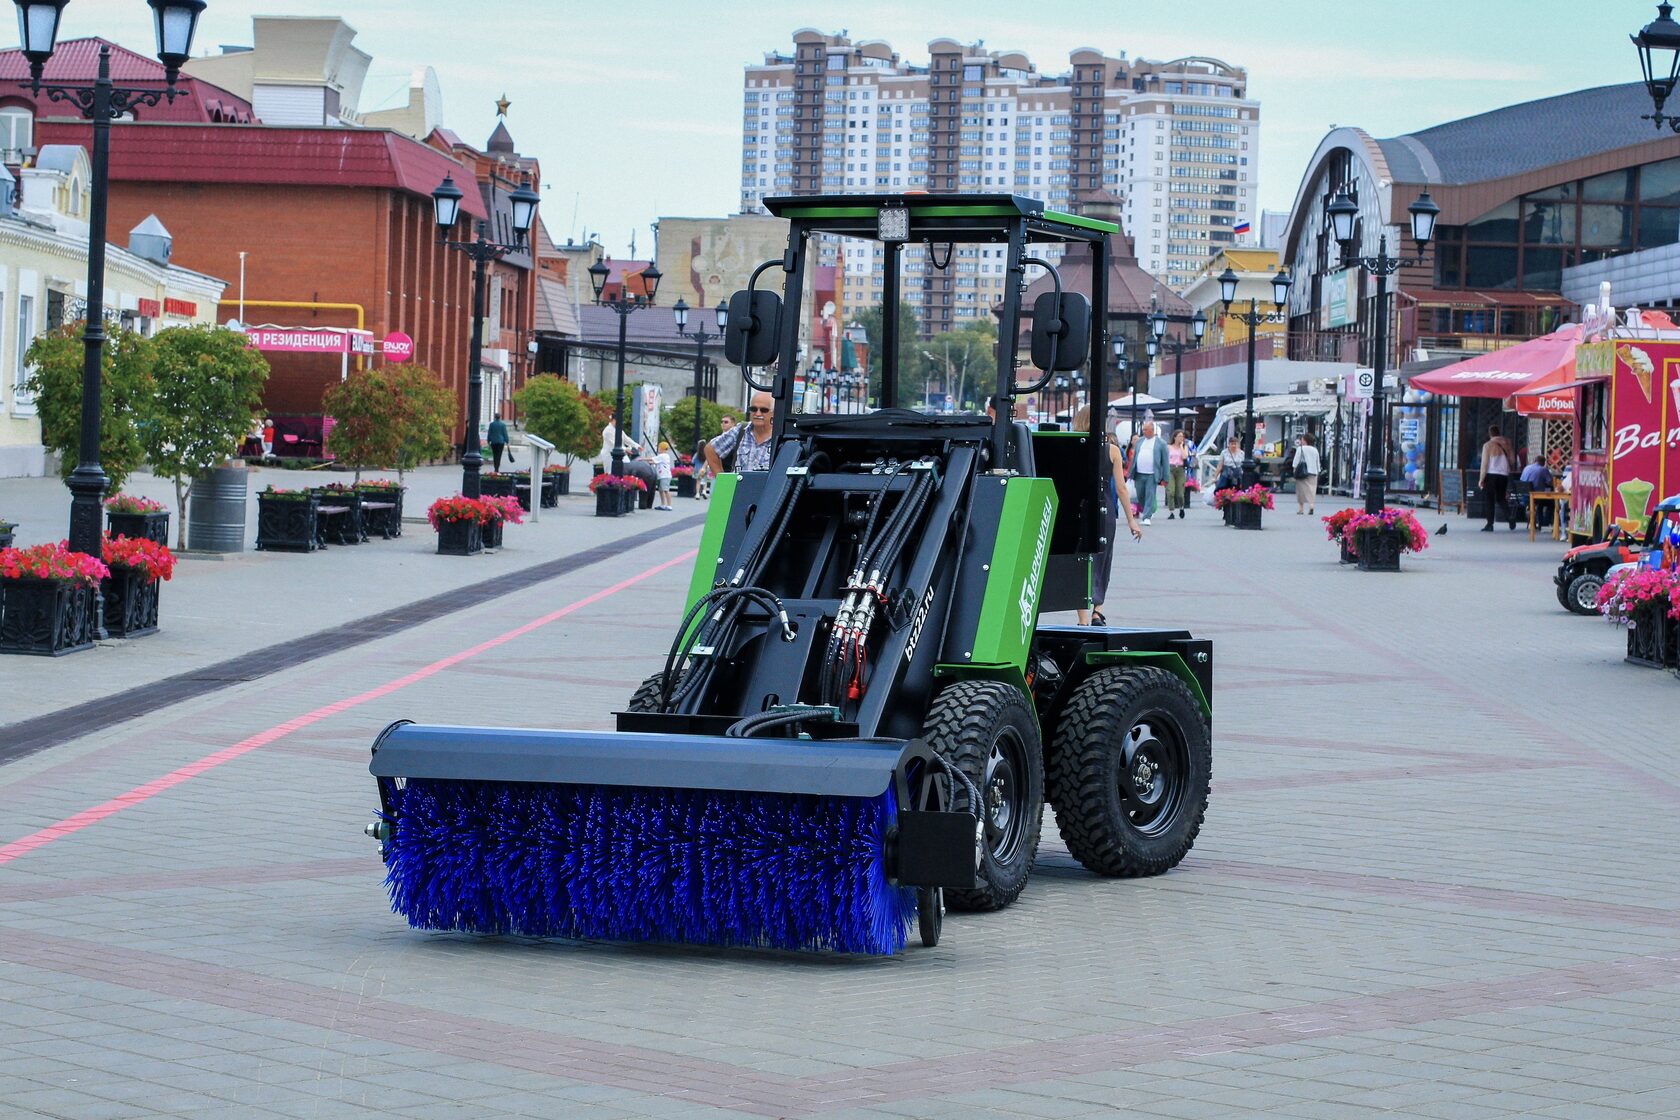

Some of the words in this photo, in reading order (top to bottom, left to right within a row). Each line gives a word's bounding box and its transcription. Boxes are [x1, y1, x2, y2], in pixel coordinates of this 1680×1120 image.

[263, 333, 341, 348] РЕЗИДЕНЦИЯ
[384, 341, 410, 351] ENJOY
[905, 585, 934, 661] btz22.ru
